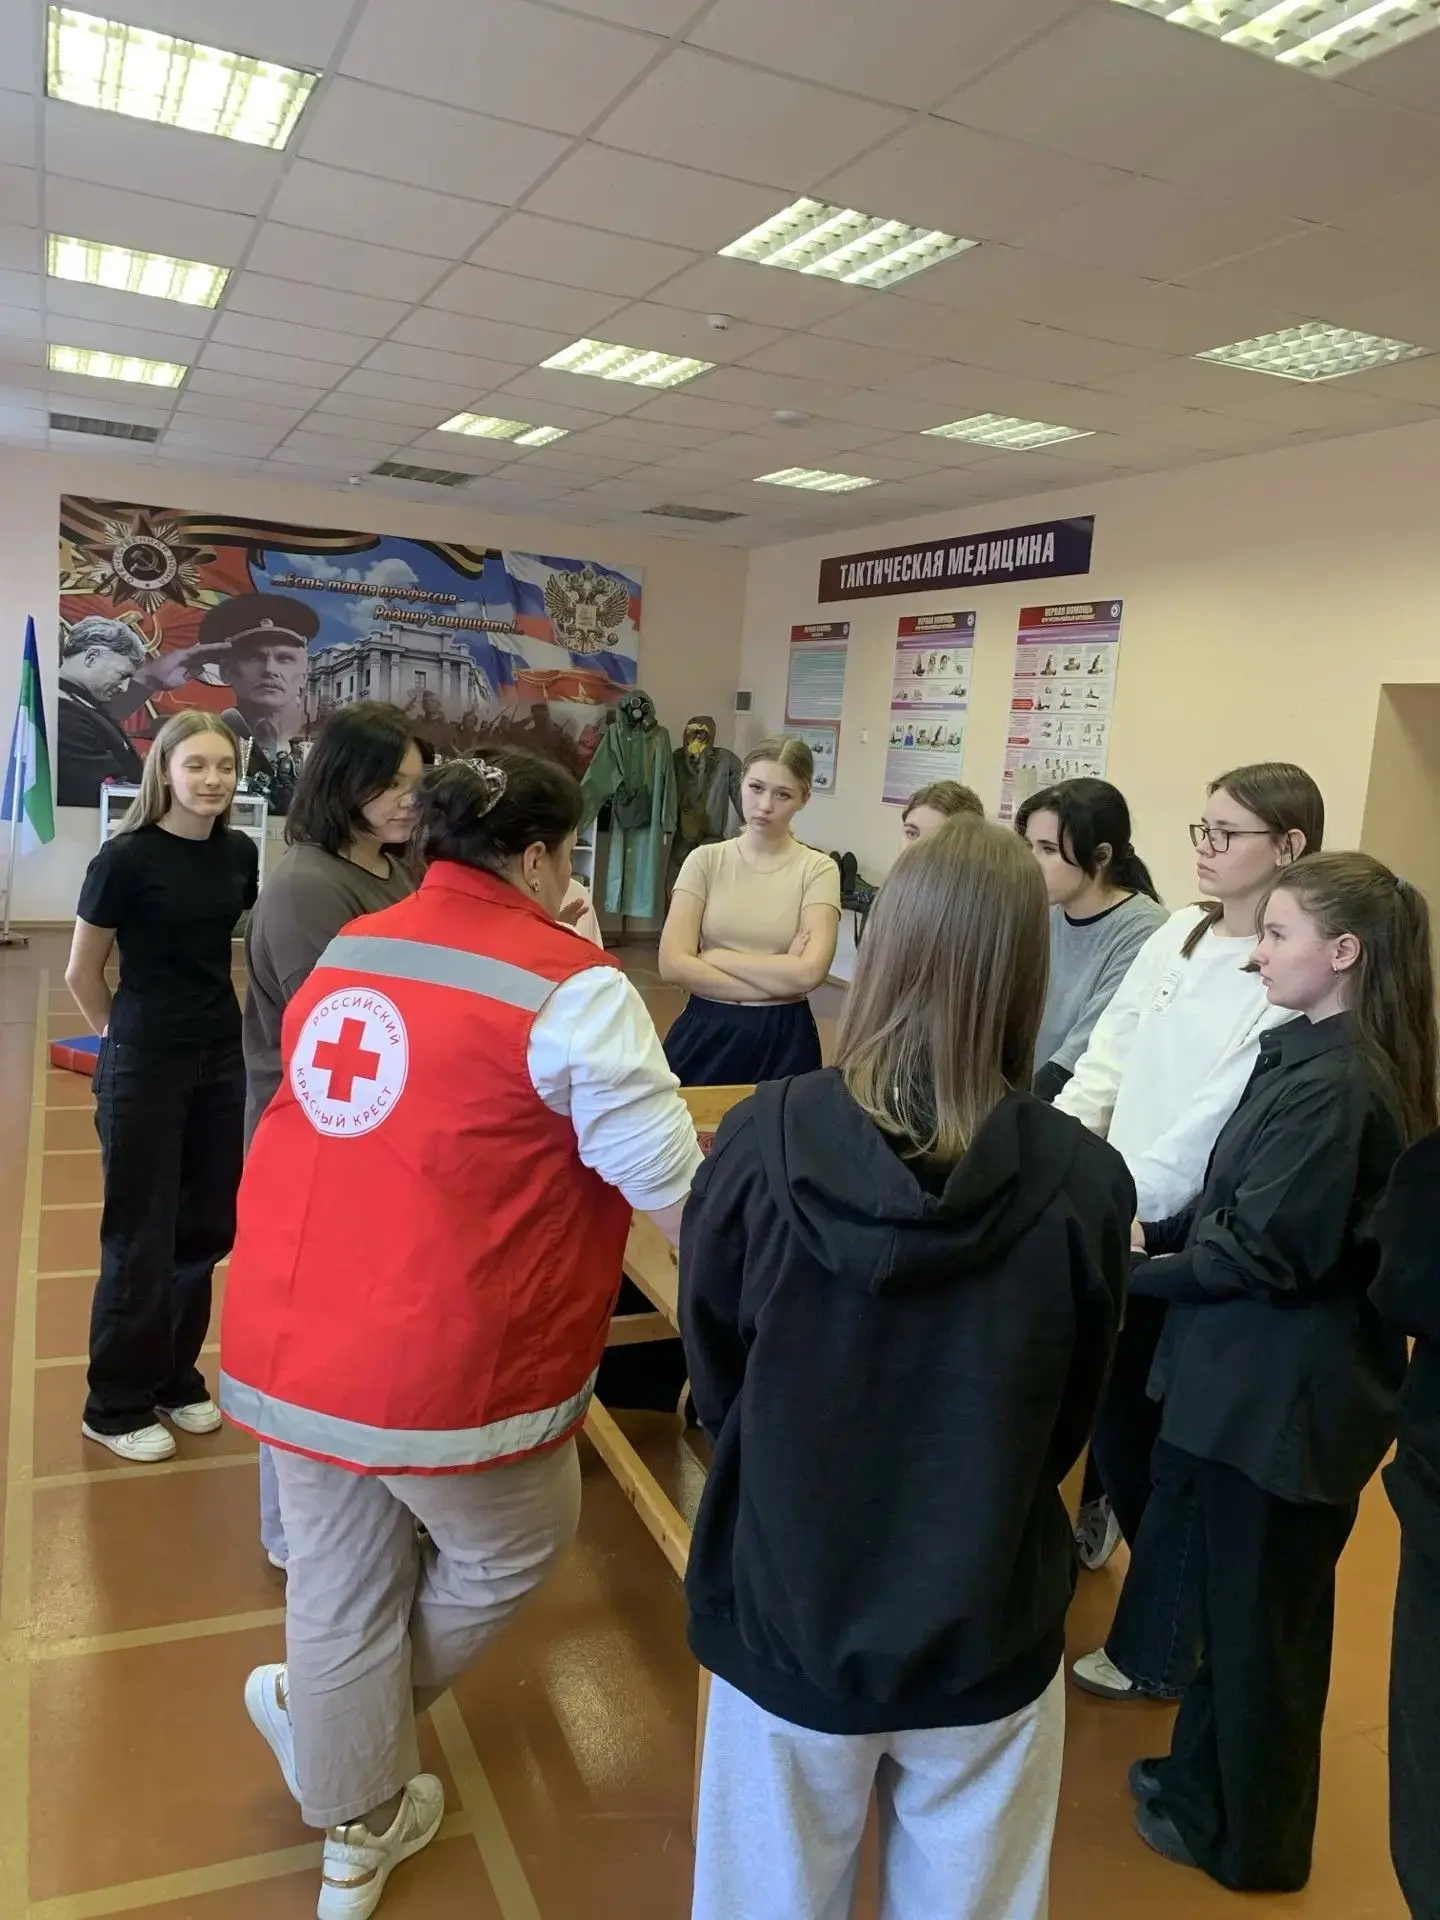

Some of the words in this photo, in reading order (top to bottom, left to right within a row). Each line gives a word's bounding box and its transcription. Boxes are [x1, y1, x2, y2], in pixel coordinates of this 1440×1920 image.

[840, 549, 944, 590] ТАКТИЧЕСКАЯ
[947, 531, 1056, 577] МЕДИЦИНА
[327, 579, 377, 596] такая
[379, 585, 457, 607] профессия
[374, 605, 428, 626] Родину
[312, 996, 402, 1046] РОССИЙСКИЙ
[296, 1067, 347, 1128] КРАСНЫЙ
[352, 1086, 393, 1127] КРЕСТ
